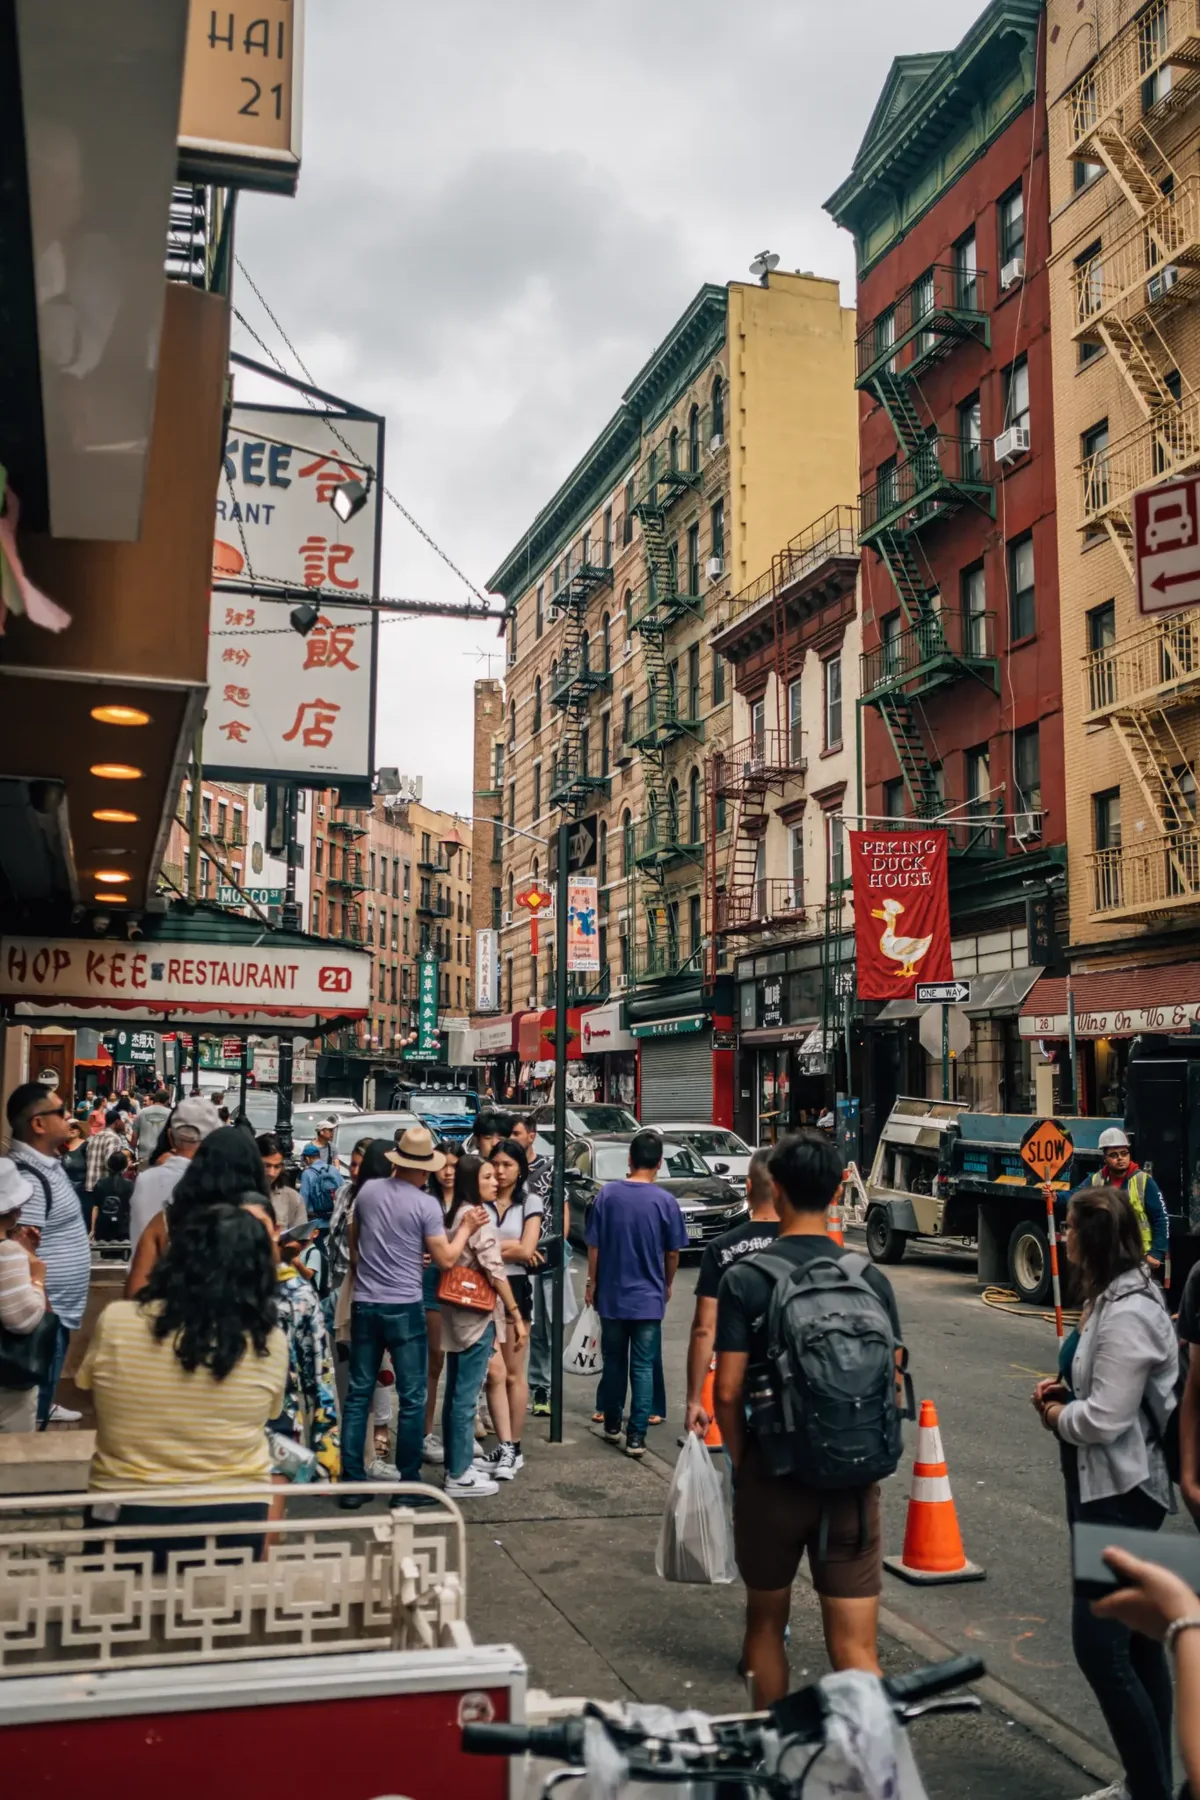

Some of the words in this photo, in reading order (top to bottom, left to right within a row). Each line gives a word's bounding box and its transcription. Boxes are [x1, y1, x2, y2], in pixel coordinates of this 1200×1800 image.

[207, 10, 284, 59] HAI
[238, 77, 282, 120] 21
[282, 449, 362, 749] 合記飯店
[861, 840, 936, 855] PEKING
[871, 856, 926, 872] DUCK
[868, 872, 931, 888] HOUSE
[7, 945, 71, 984] HOP
[86, 949, 148, 989] KEE
[168, 959, 299, 989] RESTAURANT
[323, 970, 348, 990] 21
[921, 989, 937, 998] ONE
[945, 988, 962, 997] WAY
[765, 1011, 780, 1020] COFFEE
[1039, 1018, 1049, 1030] 26
[1077, 1012, 1107, 1031] Wing
[1115, 1011, 1132, 1031] On
[1140, 1008, 1164, 1028] Wo
[1172, 1005, 1187, 1025] &
[1028, 1139, 1066, 1163] SLOW
[581, 1335, 590, 1348] I
